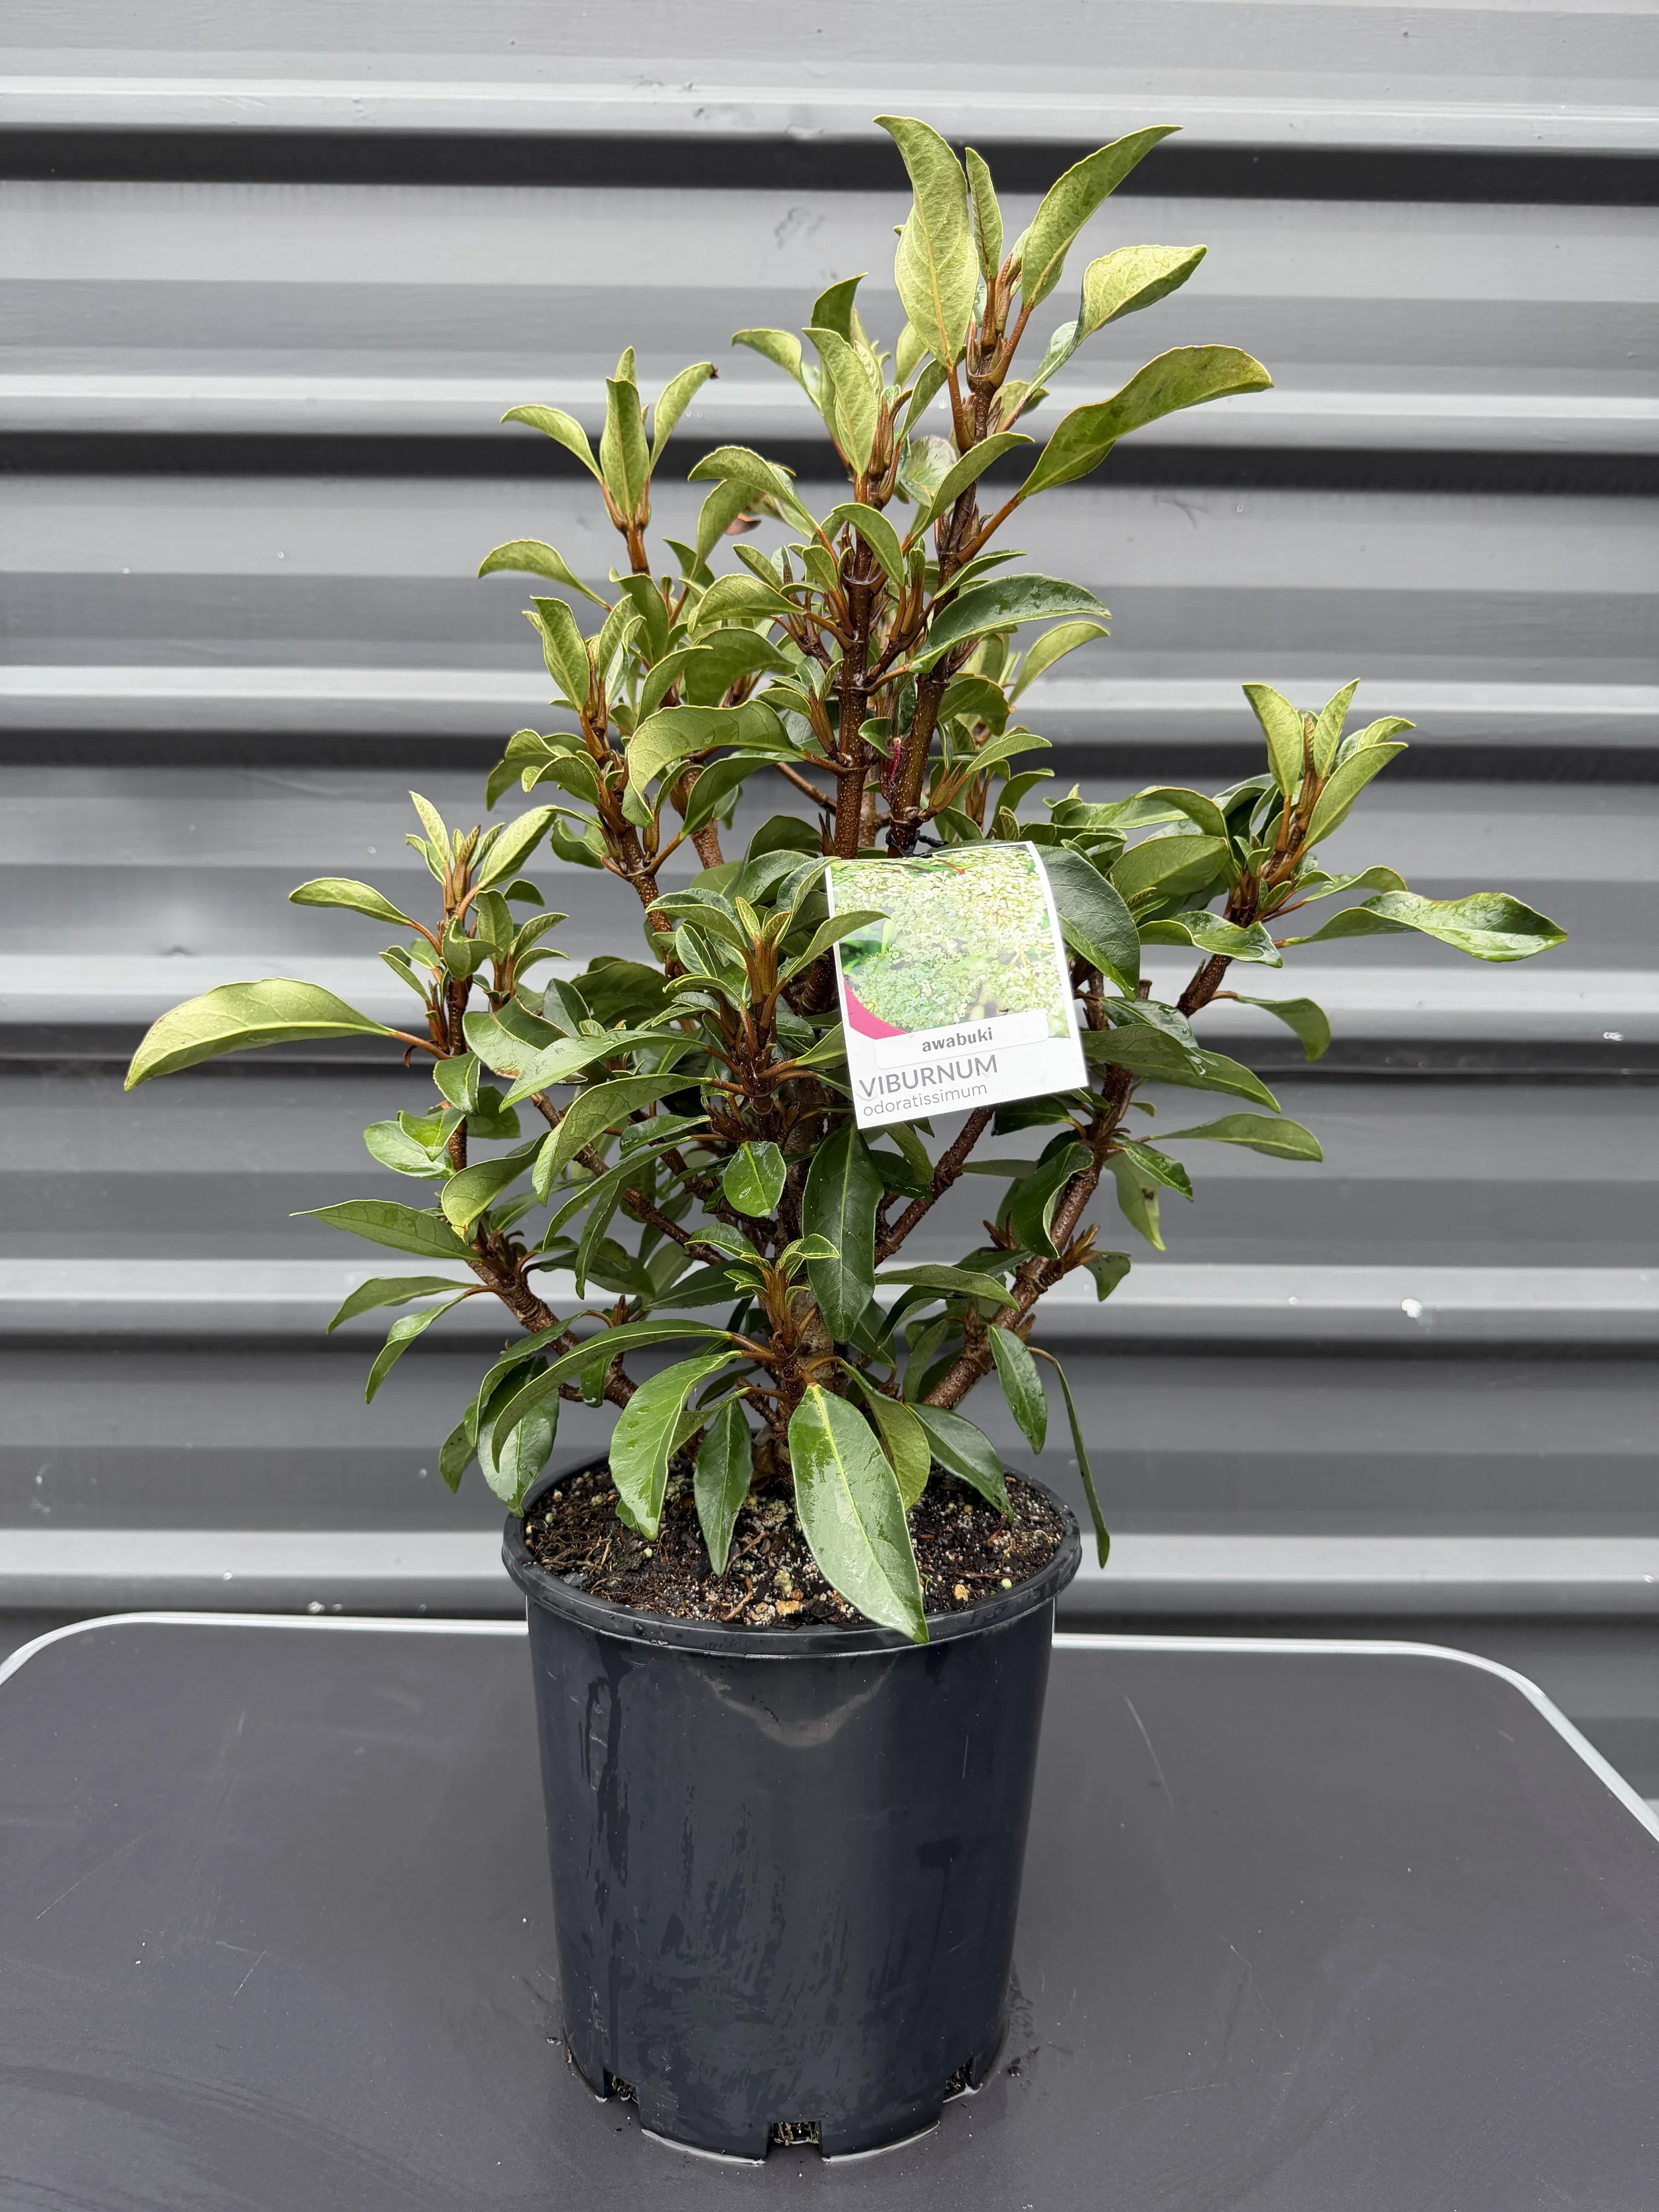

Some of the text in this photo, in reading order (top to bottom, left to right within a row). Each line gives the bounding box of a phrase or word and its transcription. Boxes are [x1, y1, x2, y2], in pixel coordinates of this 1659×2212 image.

[922, 1027, 993, 1052] awabuki
[859, 1055, 997, 1097] VIBURNUM
[863, 1084, 987, 1116] odoratissimum
